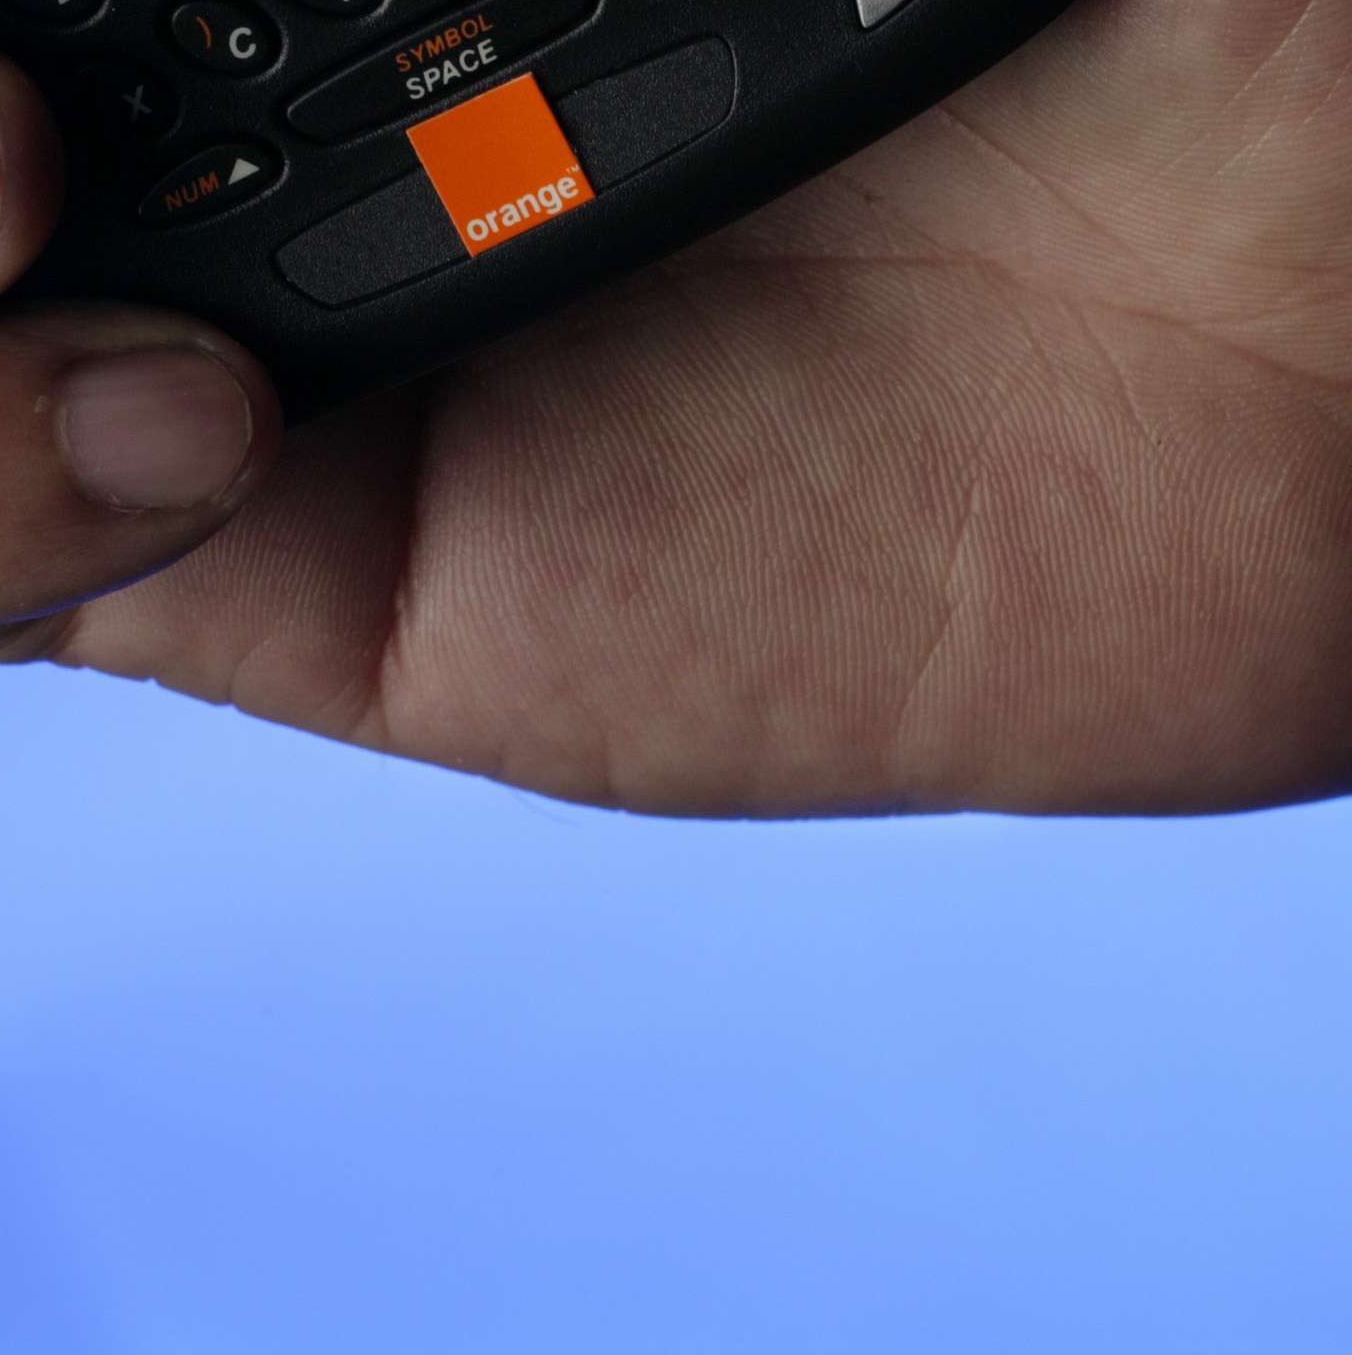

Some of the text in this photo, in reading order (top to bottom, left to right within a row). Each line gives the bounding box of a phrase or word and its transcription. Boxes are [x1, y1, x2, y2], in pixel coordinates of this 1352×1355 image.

[228, 26, 257, 59] C
[393, 13, 494, 74] SYMBOL
[406, 38, 497, 100] SPACE
[165, 171, 219, 211] NUM
